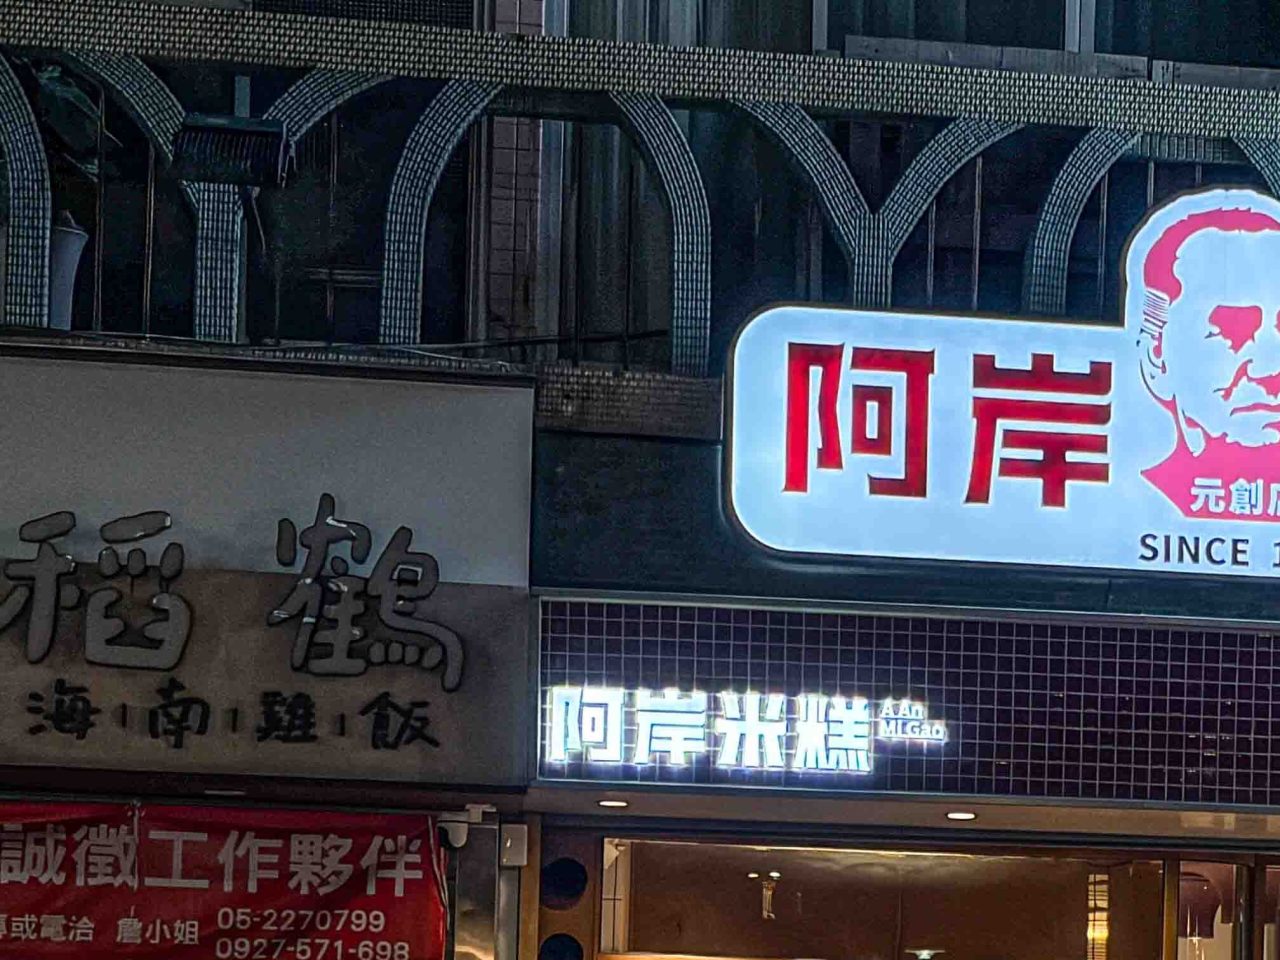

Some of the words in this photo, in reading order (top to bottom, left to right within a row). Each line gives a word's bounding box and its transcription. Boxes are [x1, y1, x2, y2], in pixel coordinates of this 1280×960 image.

[783, 341, 1113, 509] 阿岸
[1139, 531, 1251, 568] SINCE
[548, 685, 873, 774] 阿岸米糕
[0, 823, 423, 898] 誠徵工作夥伴
[216, 907, 386, 933] 05-2270799
